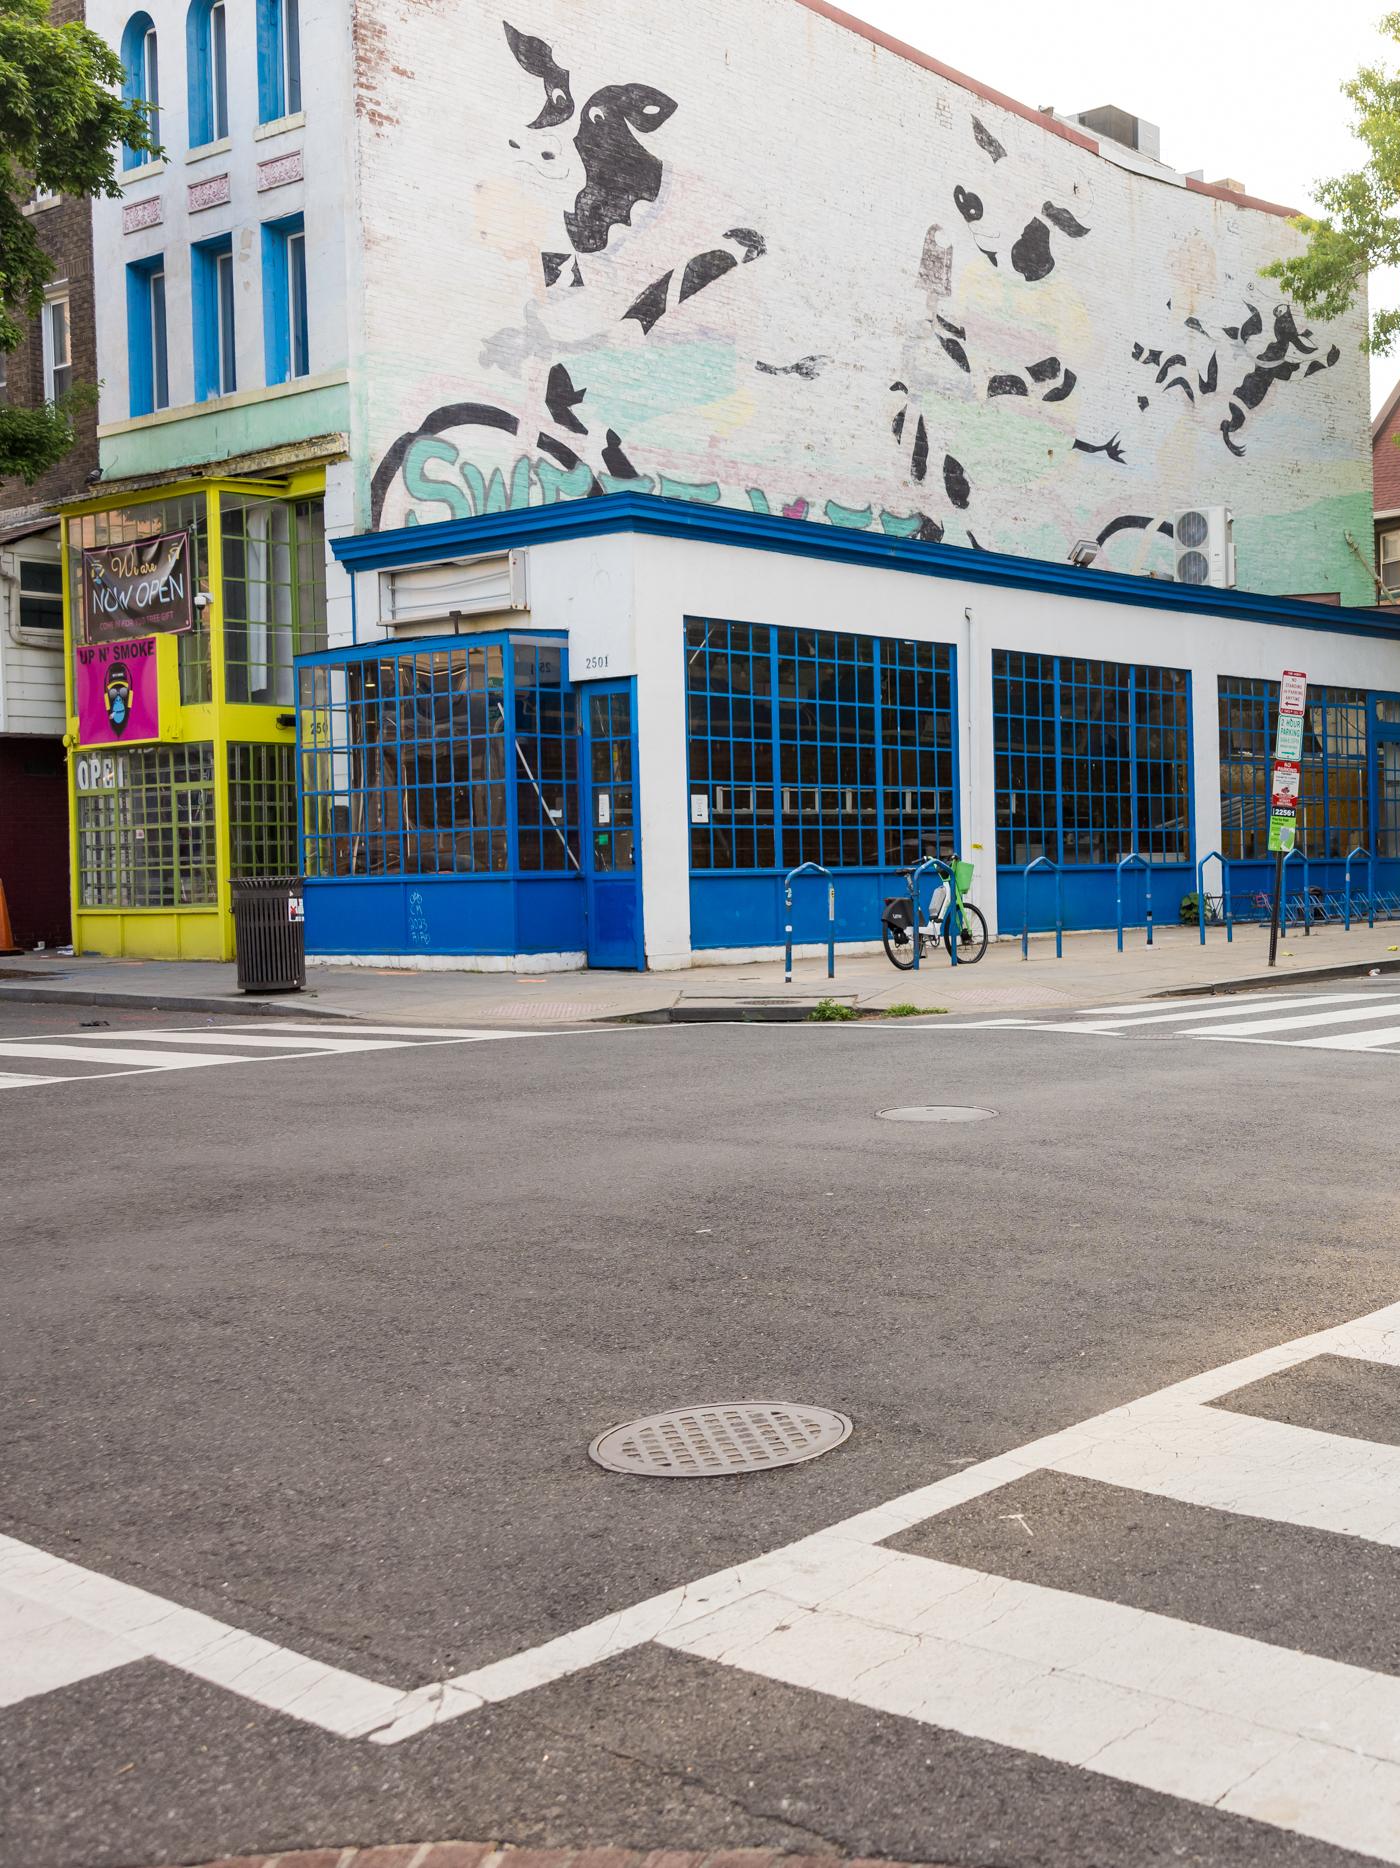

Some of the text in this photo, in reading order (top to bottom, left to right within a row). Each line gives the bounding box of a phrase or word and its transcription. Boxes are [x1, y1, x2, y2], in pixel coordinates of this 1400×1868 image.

[140, 563, 157, 576] are
[93, 573, 184, 614] NOW OPEN
[79, 641, 155, 665] UP N' SMOKE
[585, 655, 609, 669] 2501
[1286, 719, 1301, 728] HOUR
[1280, 727, 1300, 737] PARKING
